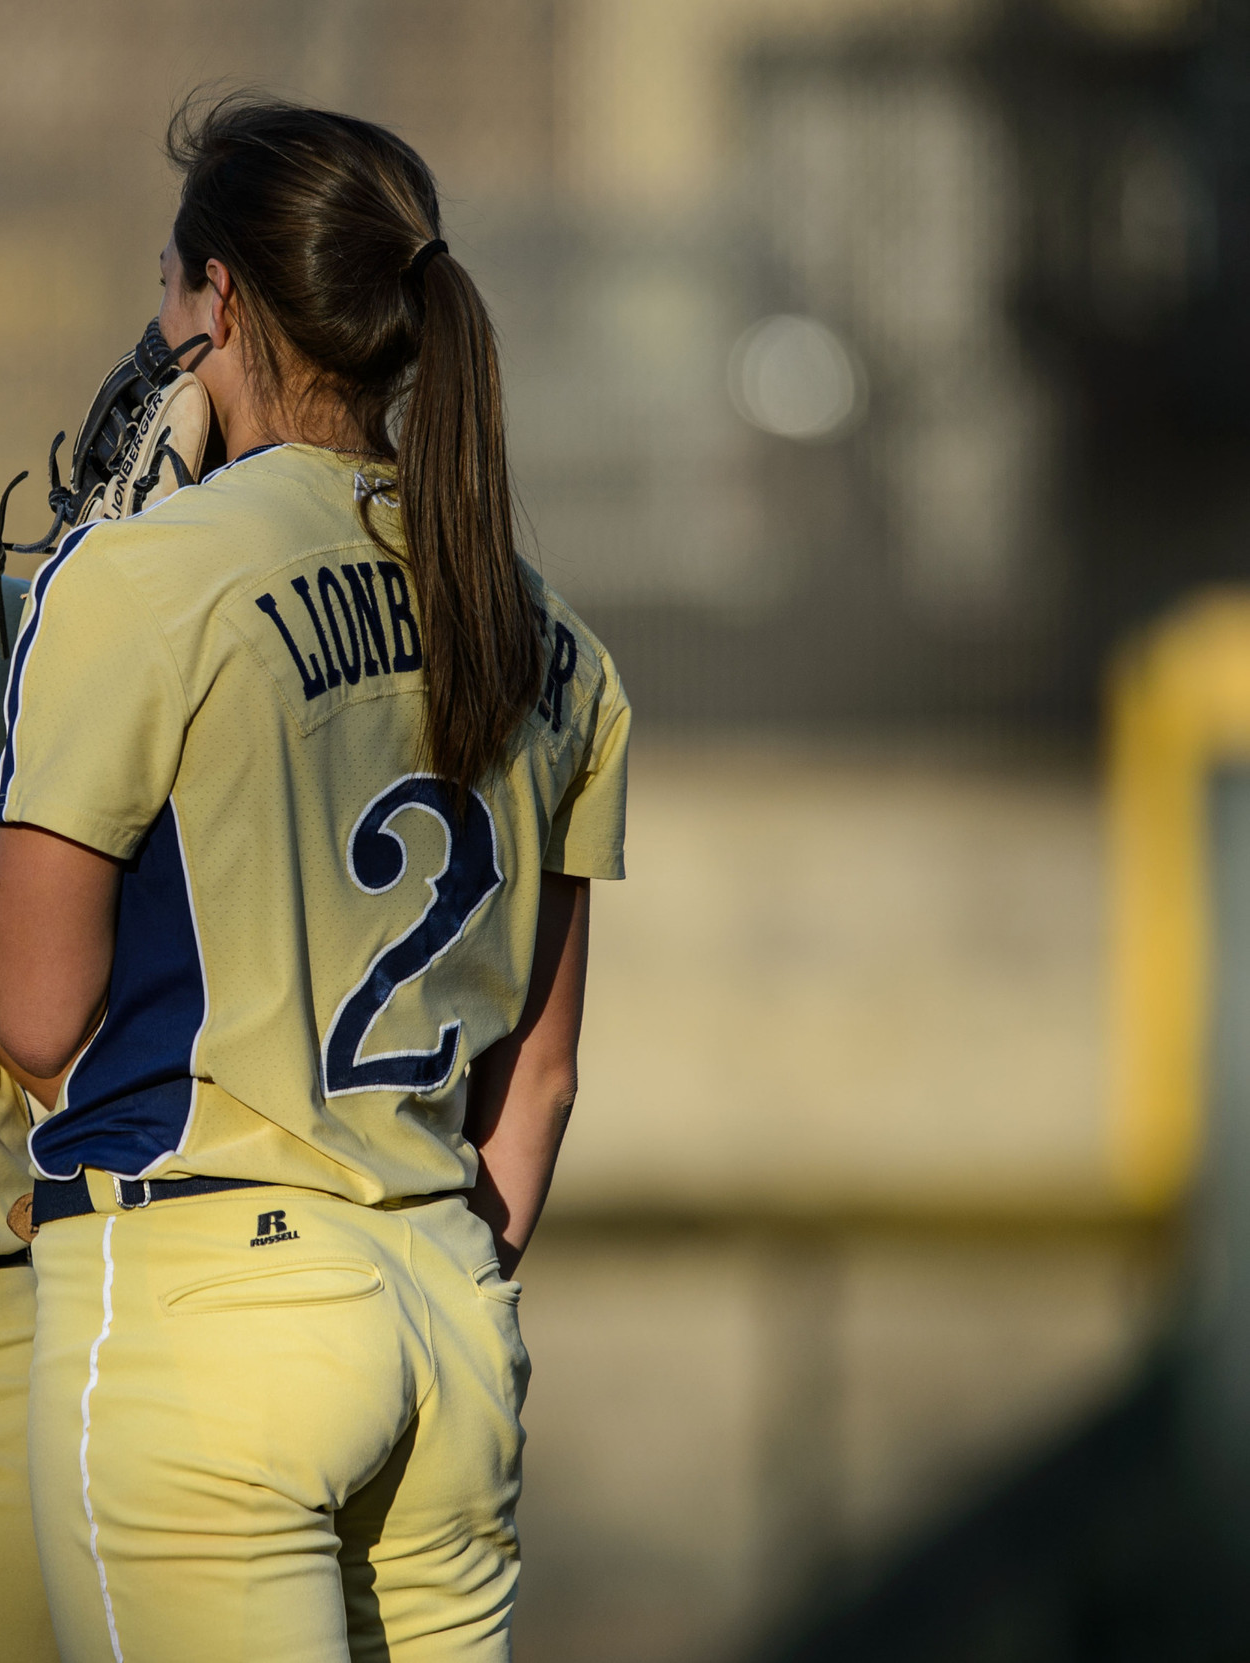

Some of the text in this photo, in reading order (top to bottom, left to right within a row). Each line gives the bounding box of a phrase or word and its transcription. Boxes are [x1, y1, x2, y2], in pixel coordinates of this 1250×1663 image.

[255, 560, 578, 734] LIONBR
[321, 772, 506, 1098] 2
[250, 1230, 301, 1248] RUSSELL
[257, 1209, 287, 1236] R
